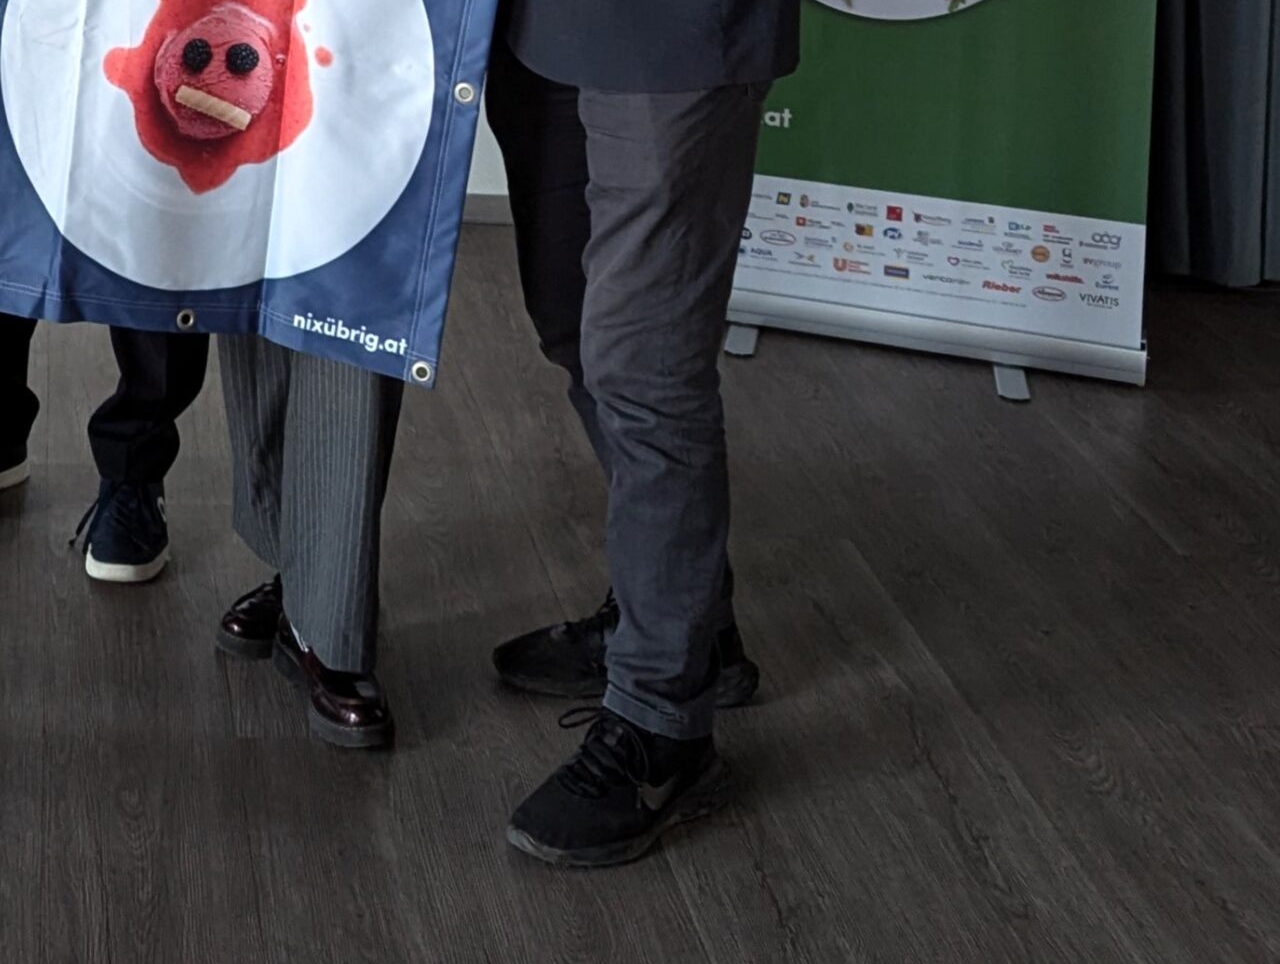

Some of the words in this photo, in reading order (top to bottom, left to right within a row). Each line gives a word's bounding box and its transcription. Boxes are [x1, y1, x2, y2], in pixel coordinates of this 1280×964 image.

[981, 279, 1022, 295] Rieber
[1078, 291, 1120, 307] VIVATIS
[293, 312, 408, 355] nixübrig.at
